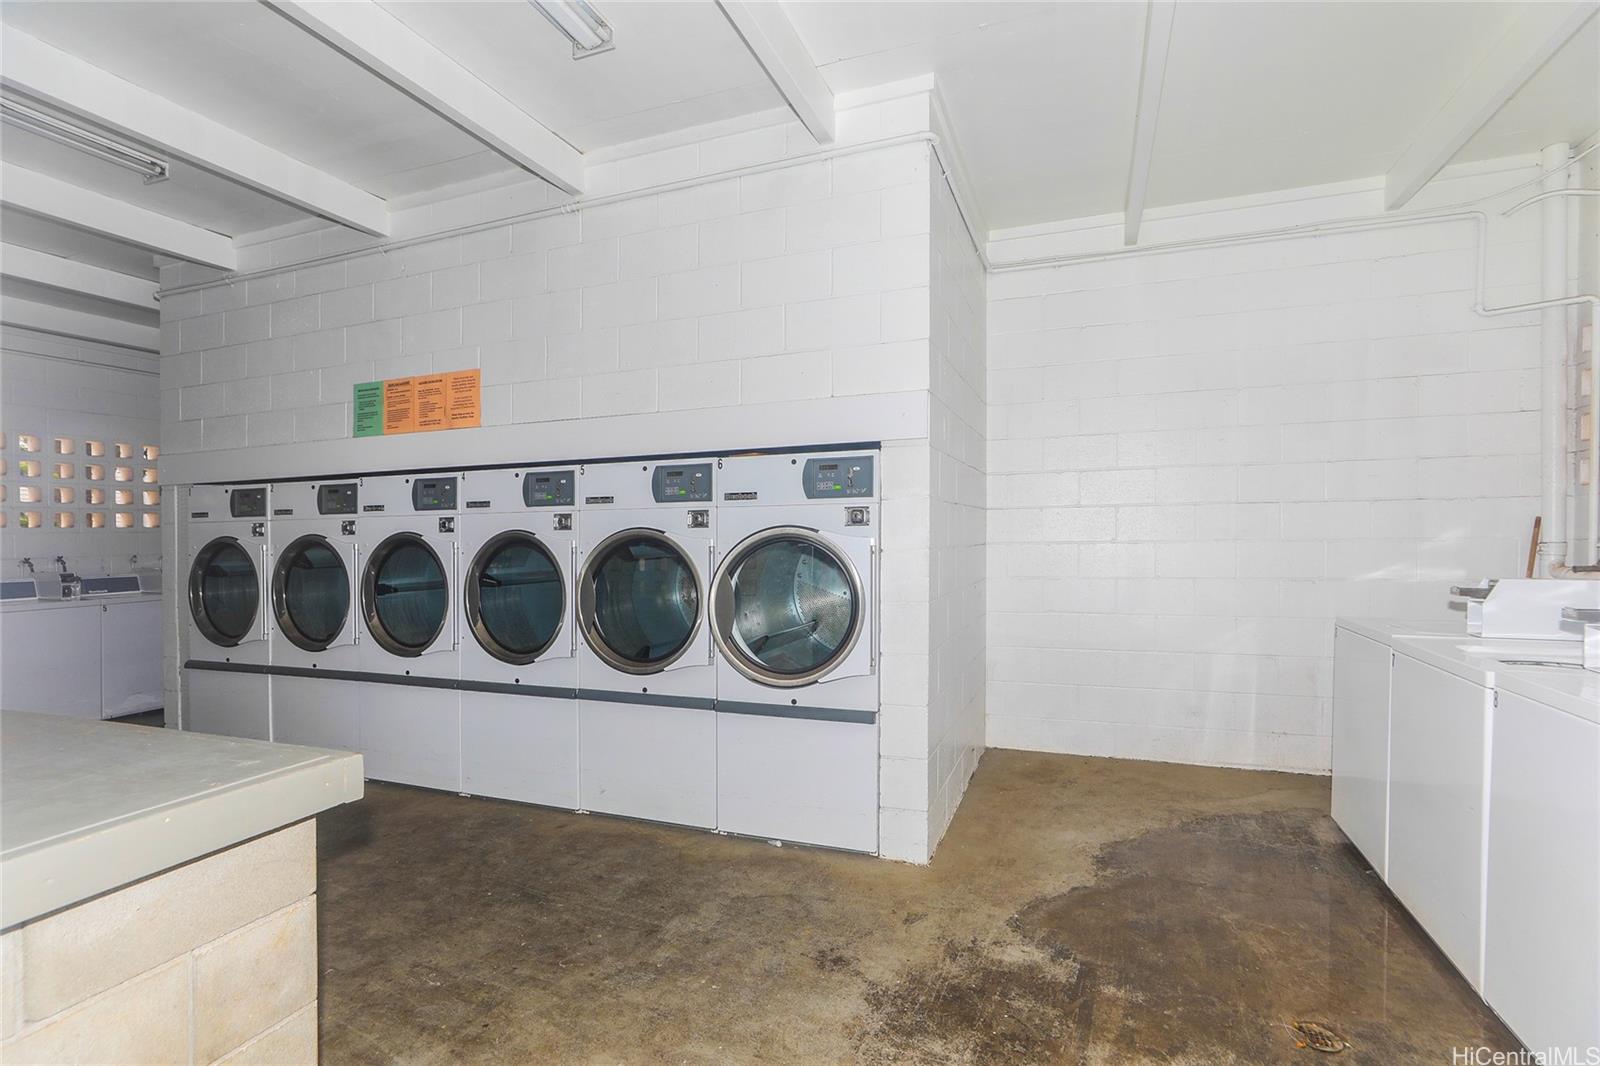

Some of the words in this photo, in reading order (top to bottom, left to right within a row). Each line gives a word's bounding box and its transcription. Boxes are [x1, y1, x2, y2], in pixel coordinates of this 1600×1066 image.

[717, 458, 723, 469] 6
[580, 464, 585, 476] 5
[461, 472, 466, 481] 4
[359, 478, 364, 487] 3
